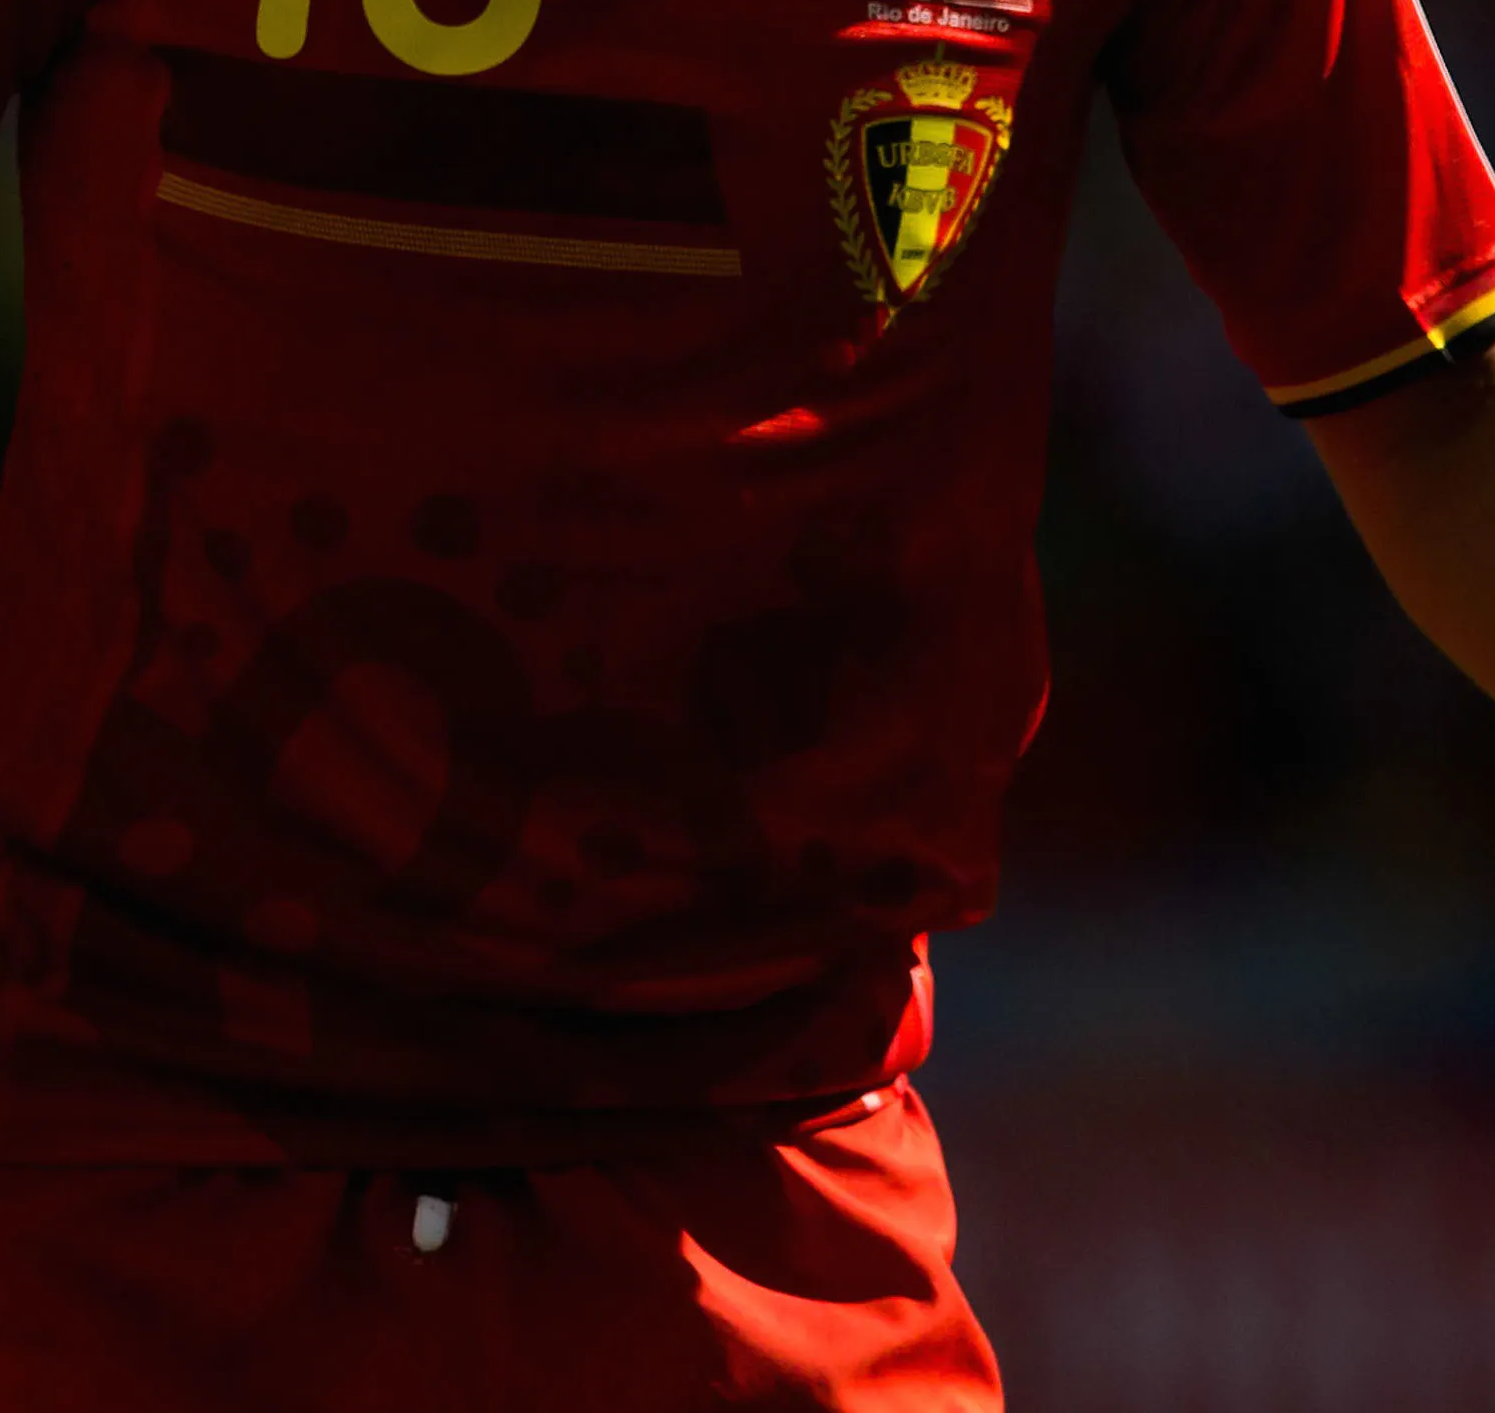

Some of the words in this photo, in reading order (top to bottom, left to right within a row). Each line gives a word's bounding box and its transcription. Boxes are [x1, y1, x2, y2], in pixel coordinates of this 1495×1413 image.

[867, 1, 903, 22] Rio
[907, 3, 933, 24] de
[936, 5, 1009, 33] Janeiro
